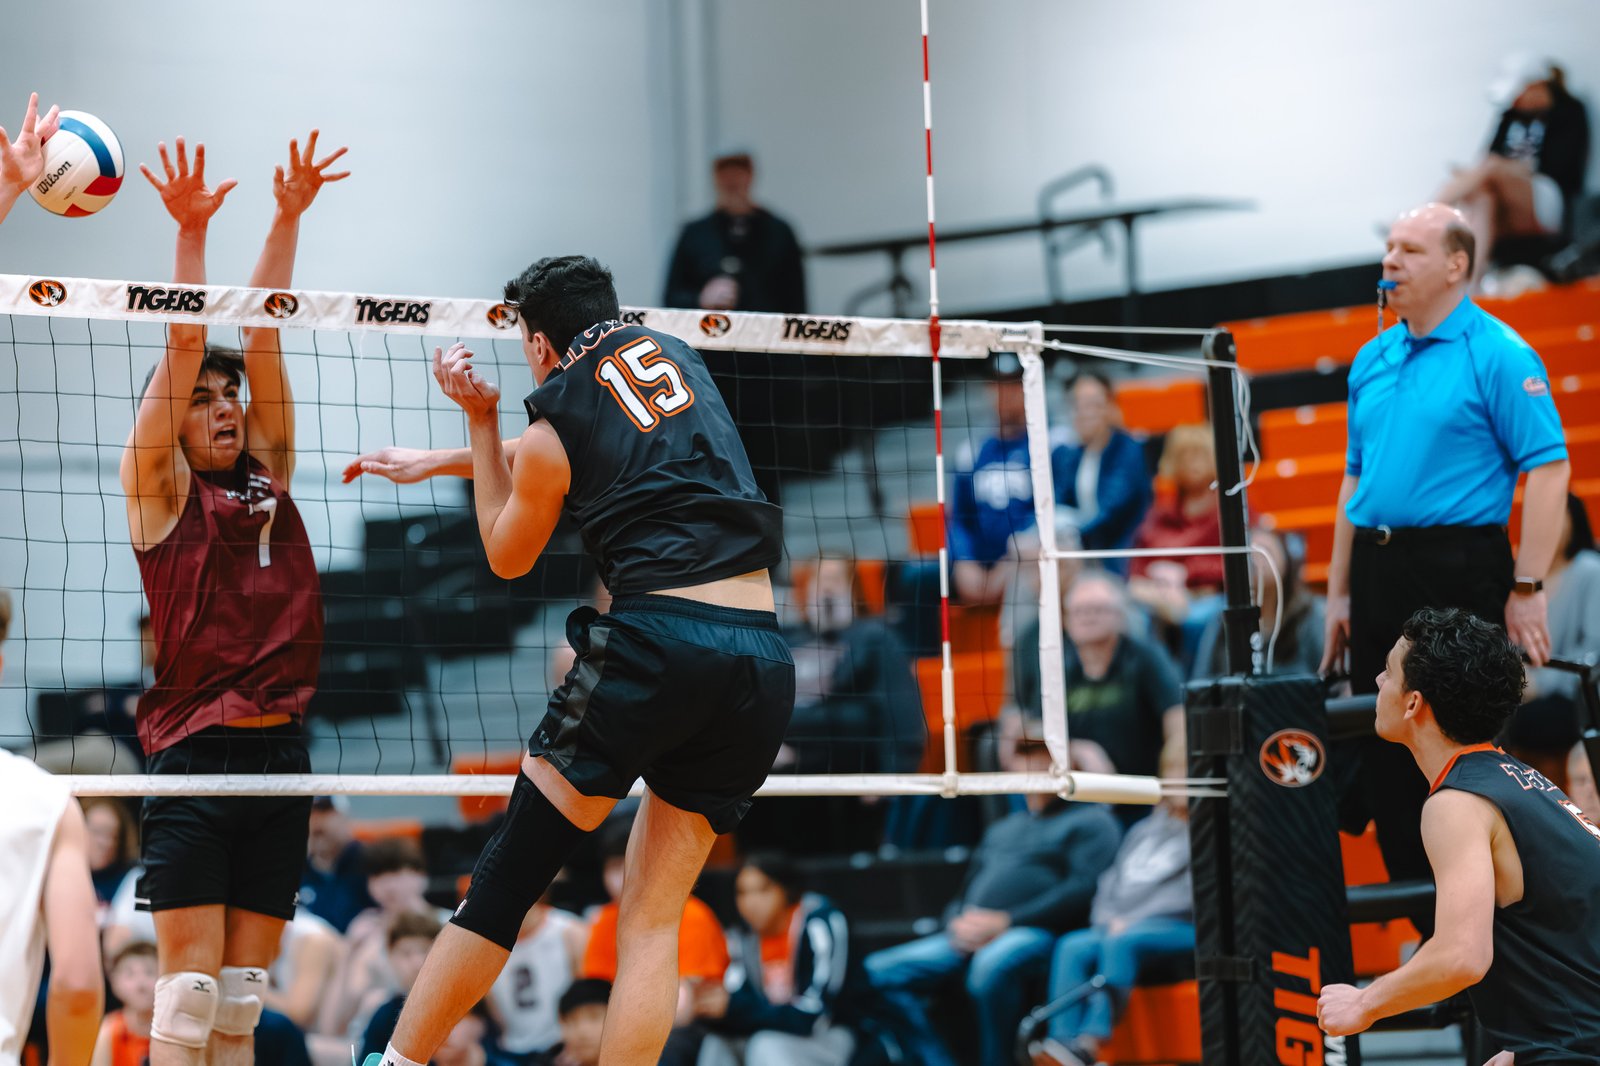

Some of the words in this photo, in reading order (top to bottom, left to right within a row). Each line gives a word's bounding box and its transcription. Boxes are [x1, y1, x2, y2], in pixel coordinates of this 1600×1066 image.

[36, 161, 72, 195] Wilson
[127, 285, 207, 313] TIGERS
[355, 298, 431, 324] TIGERS
[784, 317, 852, 340] TIGERS
[596, 337, 693, 431] 15
